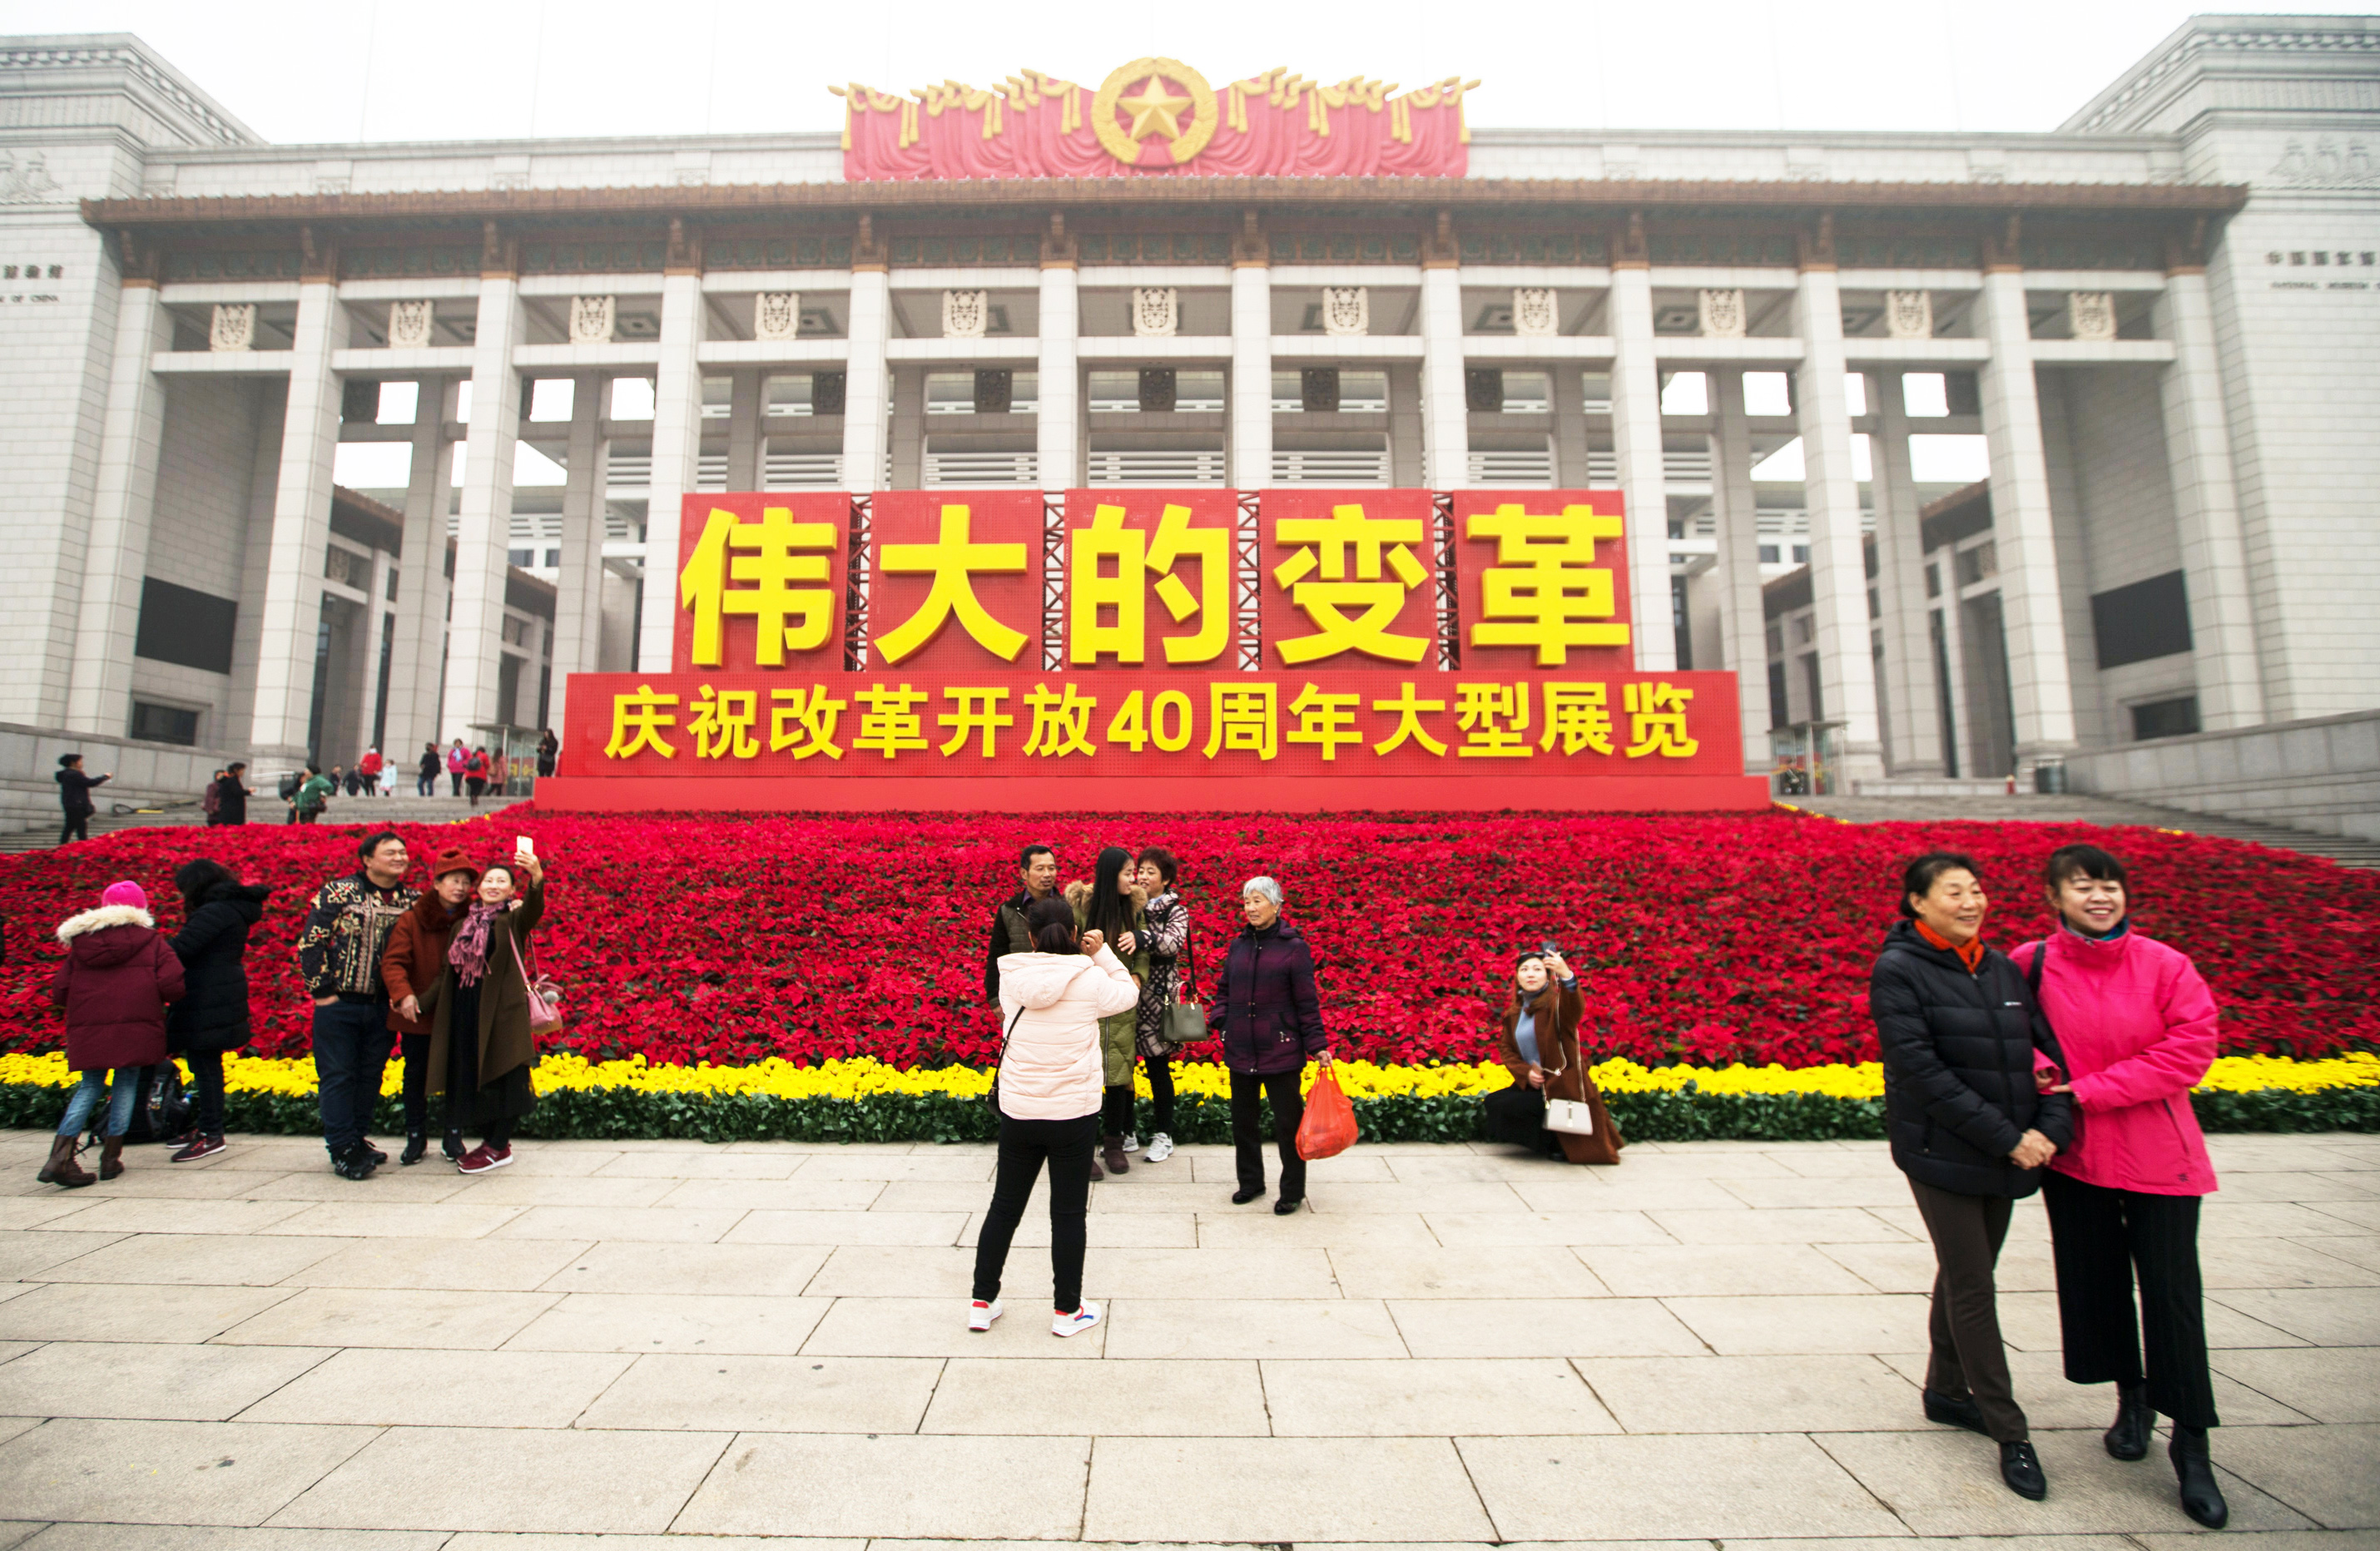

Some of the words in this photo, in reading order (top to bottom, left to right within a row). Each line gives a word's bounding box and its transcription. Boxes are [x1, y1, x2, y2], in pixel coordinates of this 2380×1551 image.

[680, 503, 1631, 667] 伟大的变革
[603, 681, 1698, 761] 庆祝改革开放40周年大型展览
